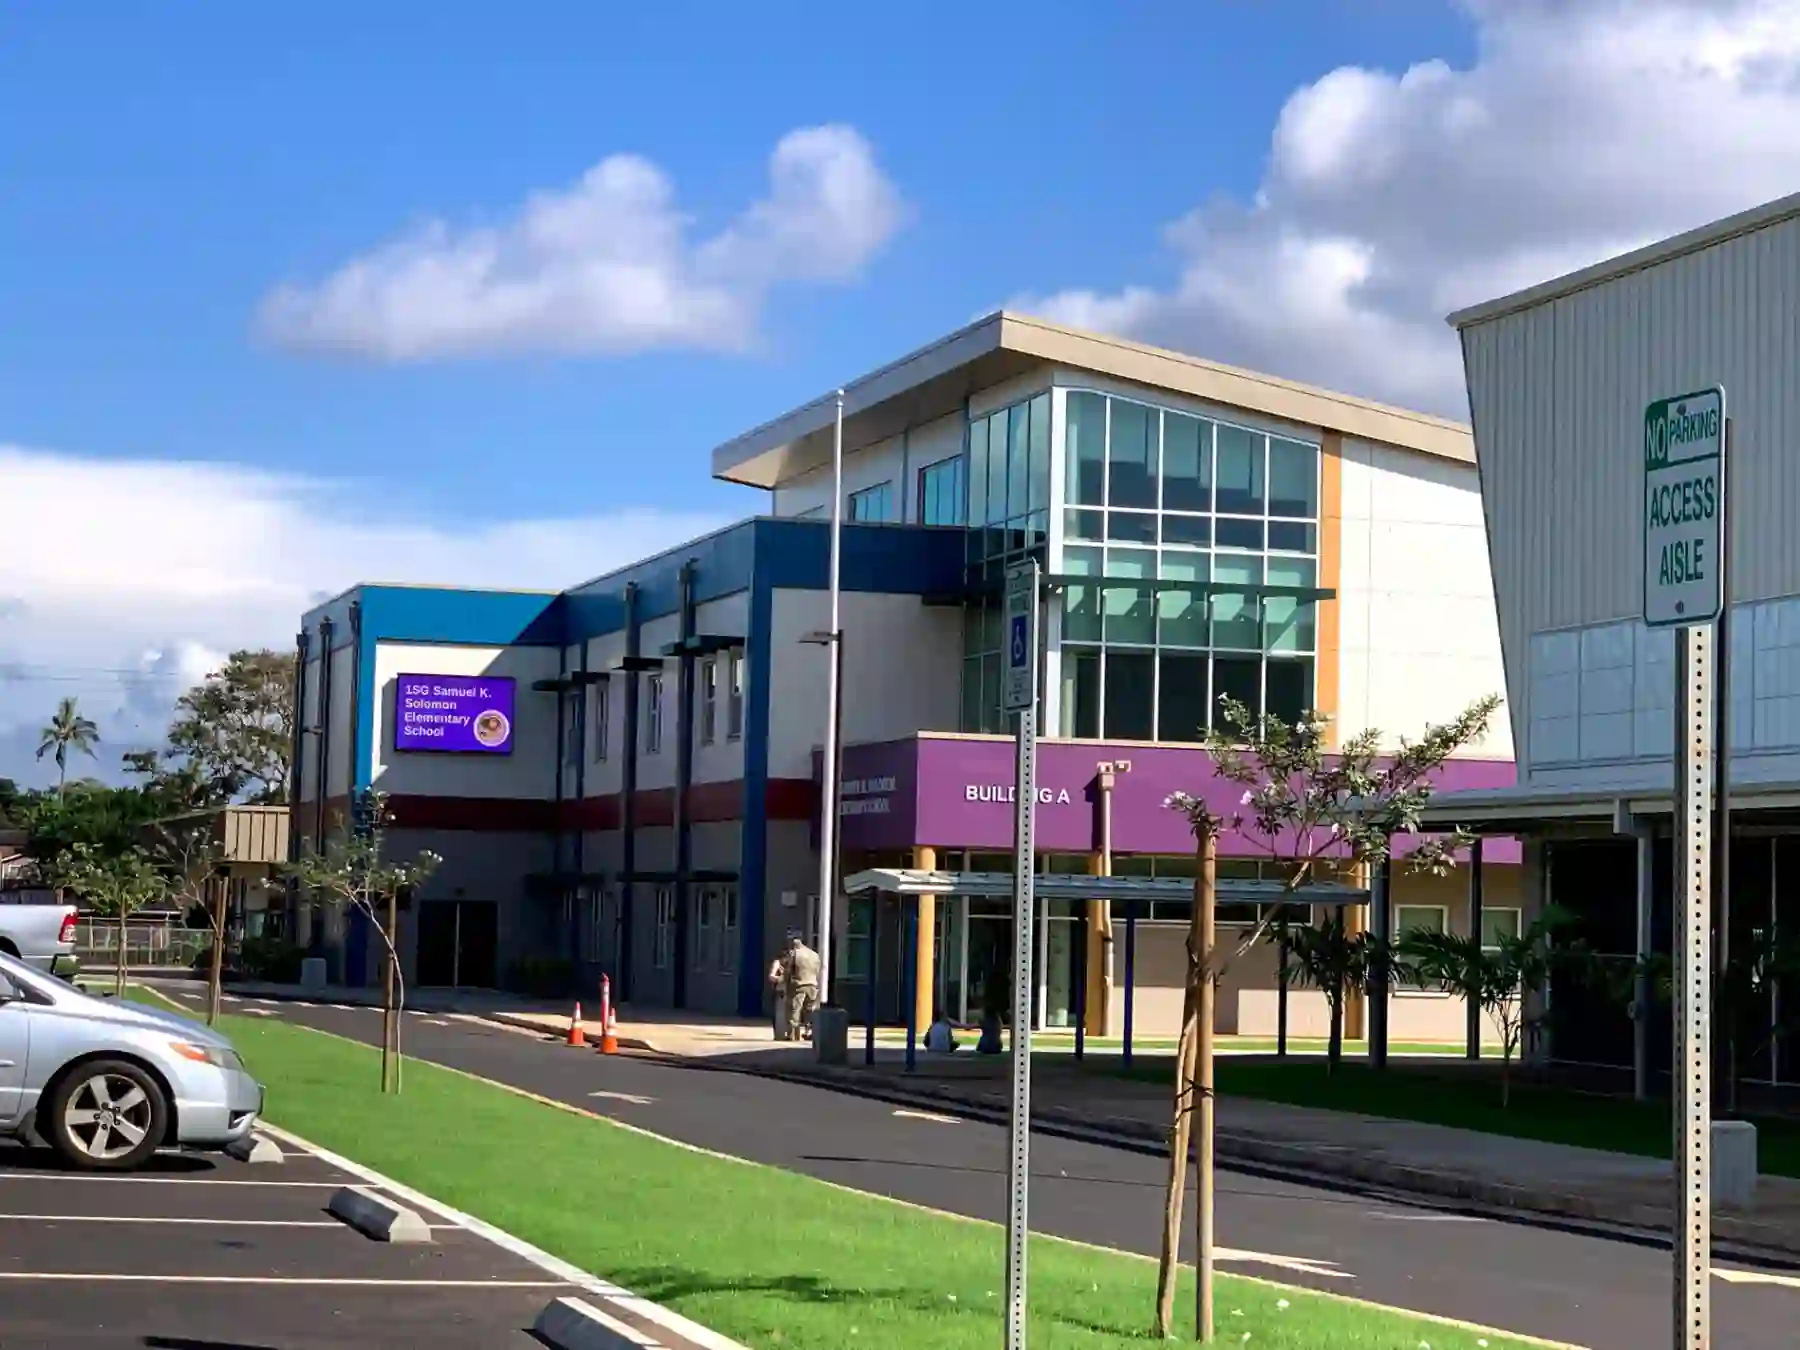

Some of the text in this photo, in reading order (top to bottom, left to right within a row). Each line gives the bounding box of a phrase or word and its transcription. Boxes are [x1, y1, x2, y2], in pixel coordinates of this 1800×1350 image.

[1647, 409, 1717, 461] NO PARKING
[1650, 475, 1714, 530] ACCESS
[1659, 538, 1704, 587] AISLE
[433, 685, 476, 697] Samuel
[480, 687, 492, 699] K.
[405, 698, 457, 710] Solomon
[404, 711, 470, 727] Elementary
[404, 725, 444, 737] School
[1056, 788, 1070, 804] A
